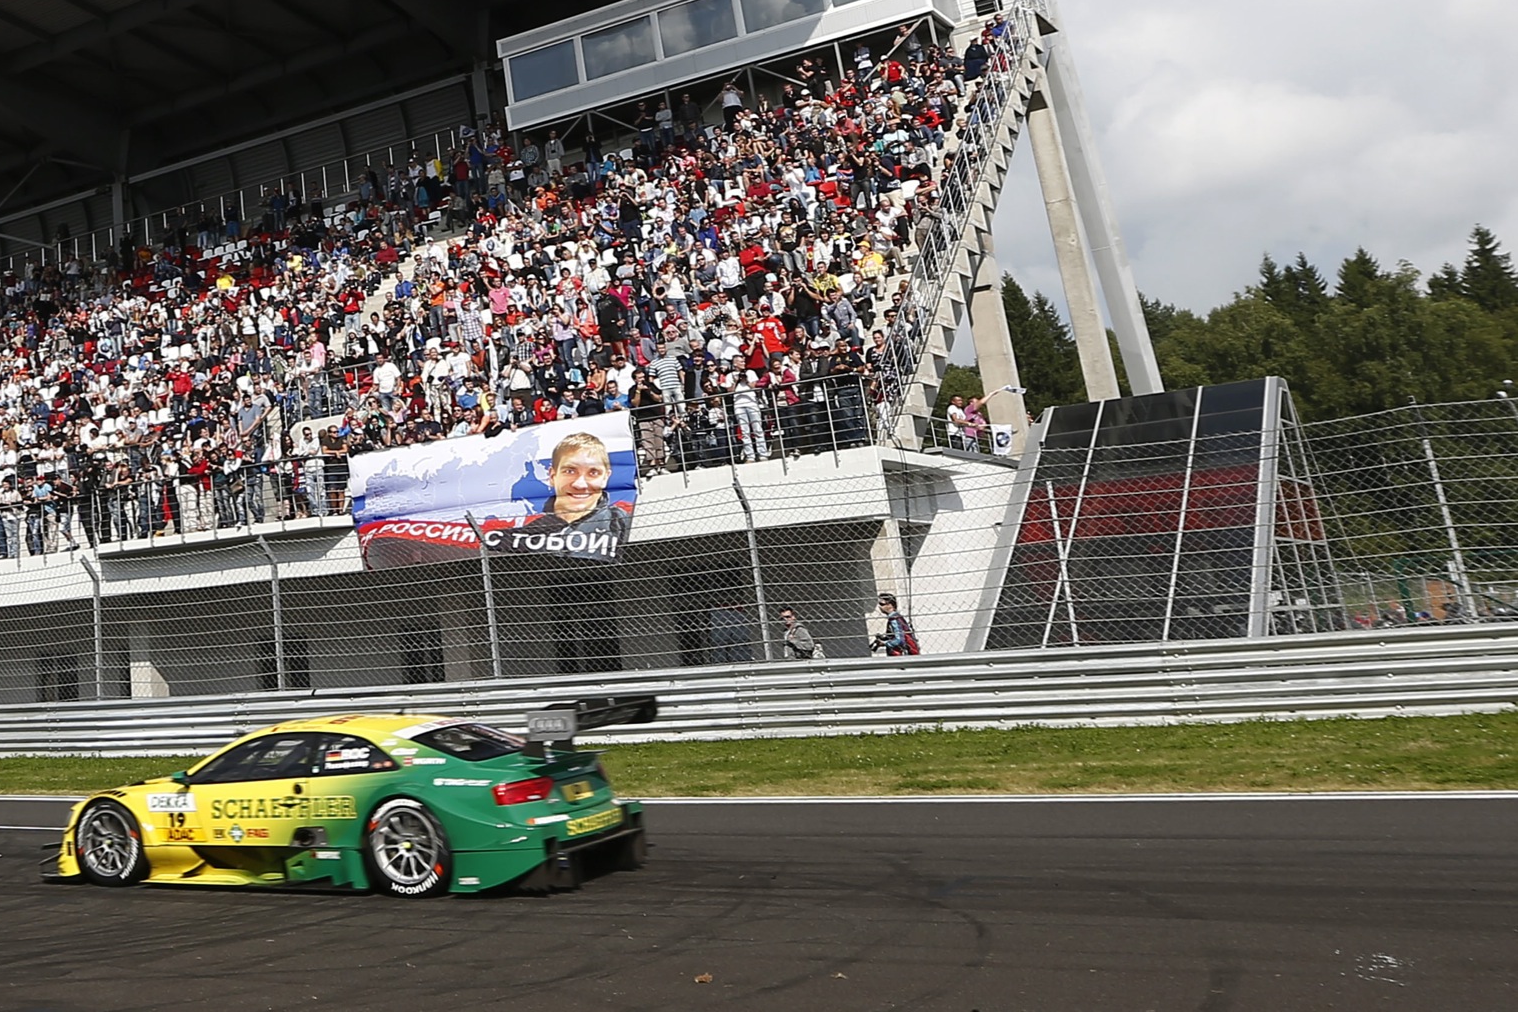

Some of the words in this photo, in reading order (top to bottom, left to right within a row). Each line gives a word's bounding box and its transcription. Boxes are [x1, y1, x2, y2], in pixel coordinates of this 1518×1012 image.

[378, 522, 477, 543] РОССИЯ
[484, 530, 504, 547] С
[511, 526, 619, 558] ТОБОЙ!
[211, 796, 357, 819] SCHAEFFLER
[168, 812, 186, 828] 19
